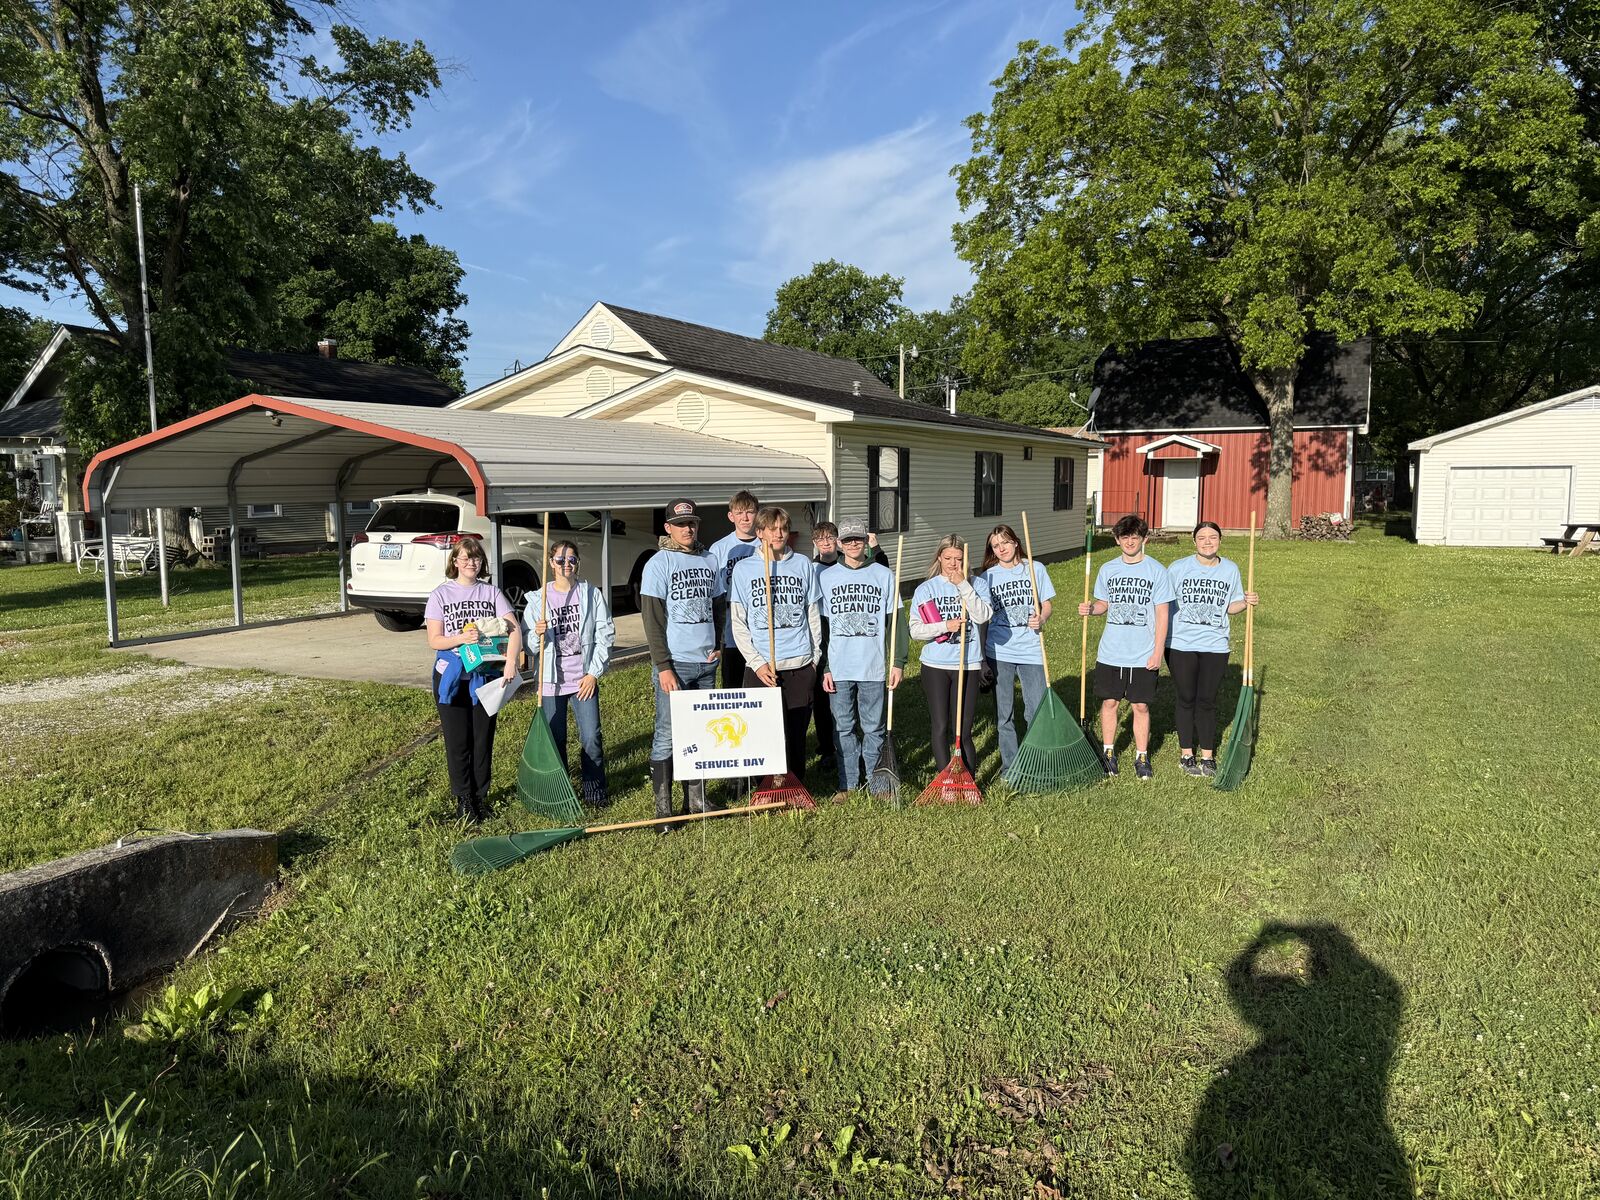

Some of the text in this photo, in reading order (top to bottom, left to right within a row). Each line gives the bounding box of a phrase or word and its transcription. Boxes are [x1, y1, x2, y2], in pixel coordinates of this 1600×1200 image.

[672, 568, 716, 583] RIVERTON
[1107, 577, 1154, 590] RIVERTON
[1182, 579, 1230, 592] RIVERTON
[671, 588, 714, 600] CLEAN U
[752, 586, 804, 597] COMUNITY
[832, 584, 882, 596] RIVERTON
[1108, 587, 1152, 597] COMMUNITY
[1182, 588, 1227, 599] COMMUNITY
[752, 595, 803, 607] CLAN UP
[830, 594, 881, 604] COMMUNITY
[994, 597, 1024, 611] CLEAN
[1138, 596, 1150, 605] UP
[1182, 595, 1225, 606] CLEAN UP
[443, 601, 496, 614] RIVERTON
[831, 603, 880, 614] CLEAN UP
[709, 692, 746, 700] PROUD
[693, 701, 763, 711] PARTICIPANT
[682, 744, 698, 757] #45
[695, 758, 765, 770] SERVICE DAY
